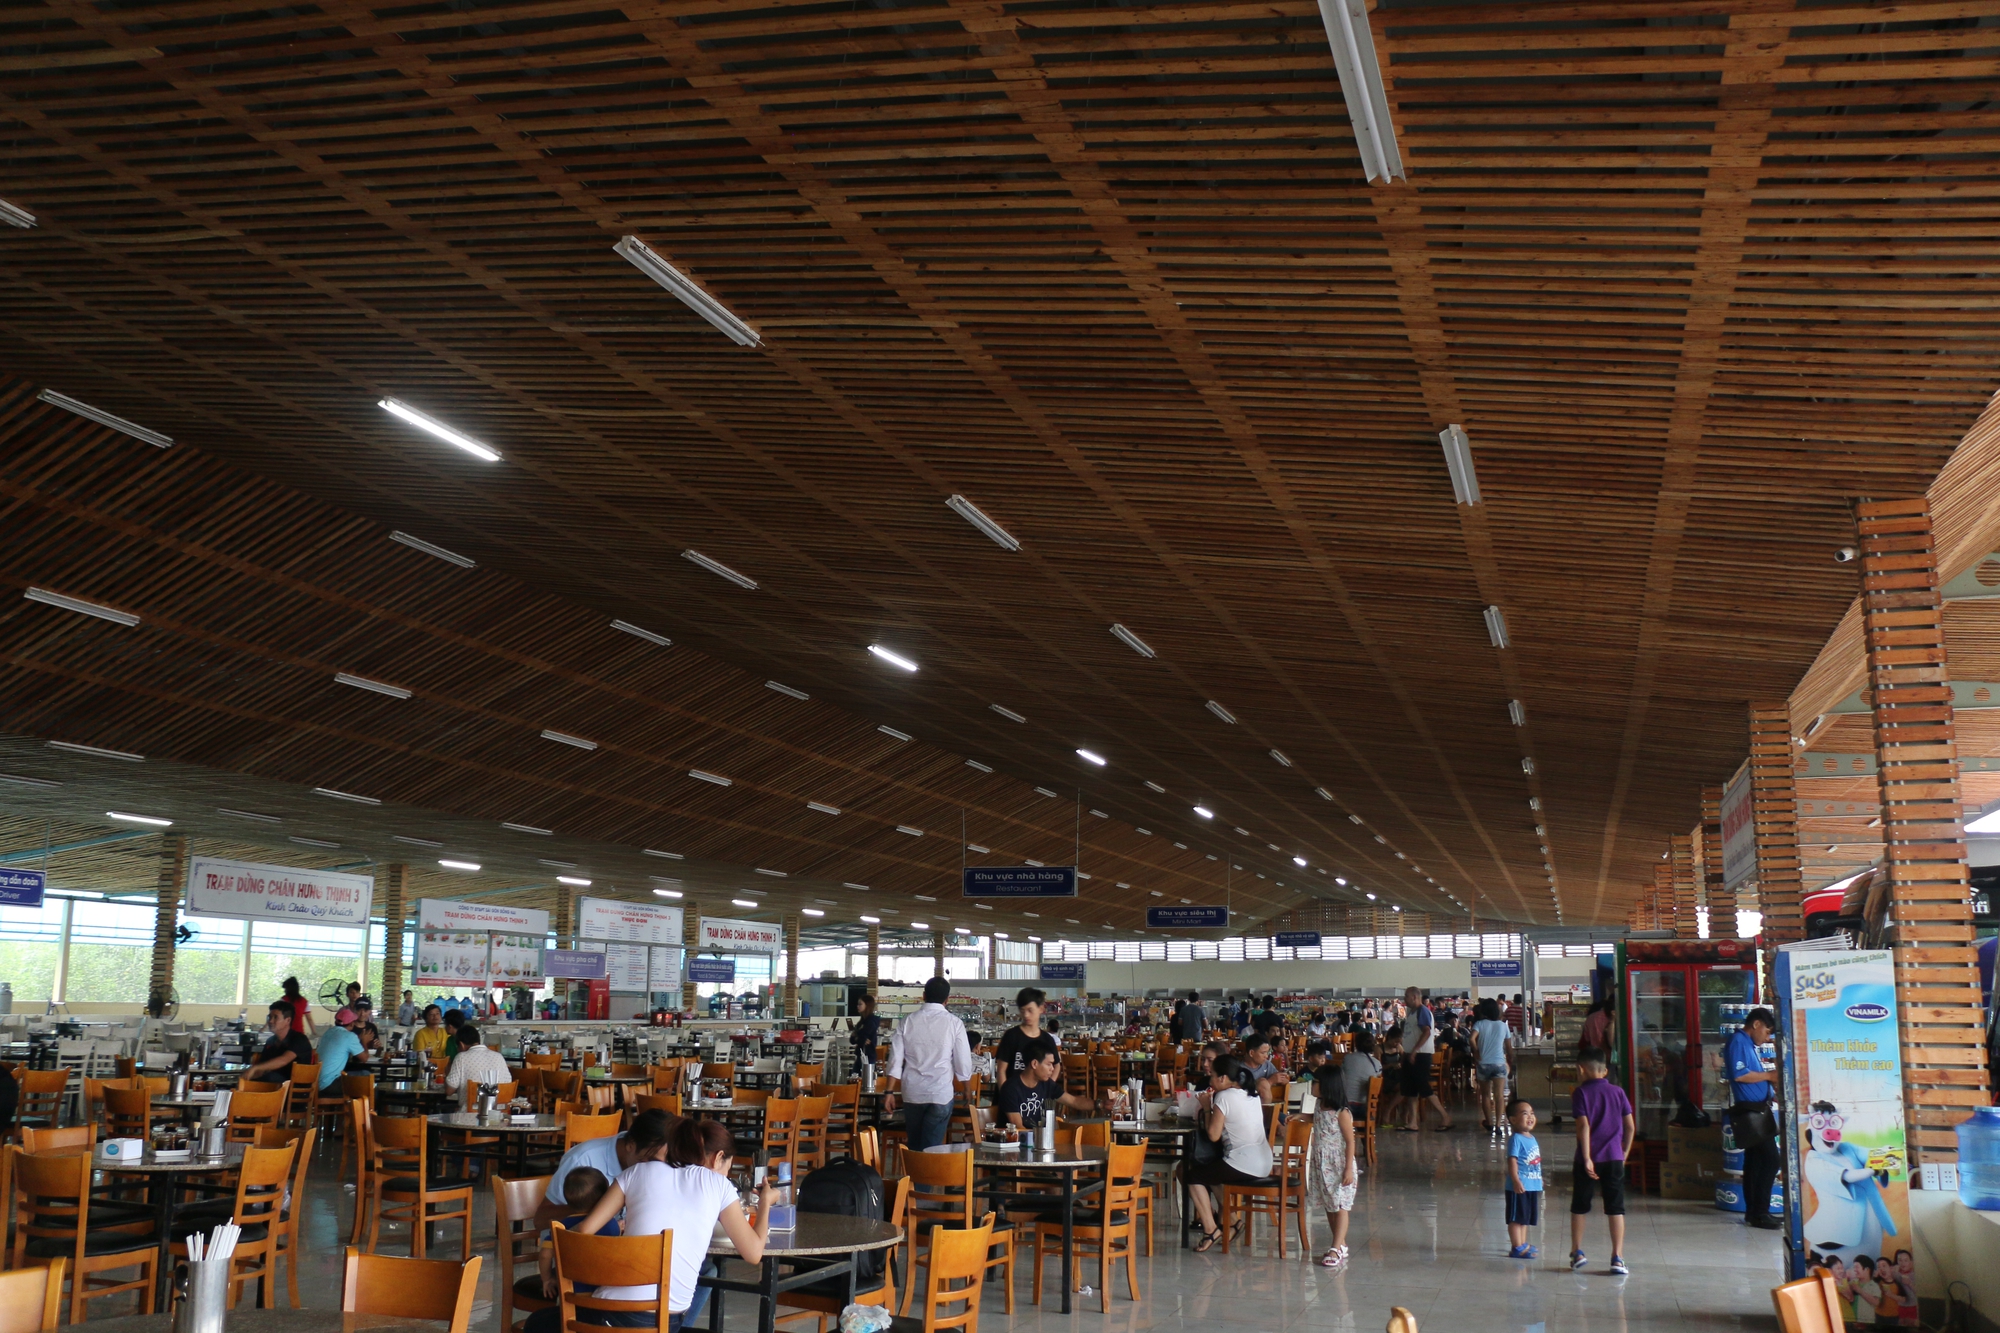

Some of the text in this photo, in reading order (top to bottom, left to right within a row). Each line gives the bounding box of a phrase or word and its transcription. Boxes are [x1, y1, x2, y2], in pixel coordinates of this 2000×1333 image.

[974, 871, 1064, 882] Khu vực nhà hàng
[206, 872, 360, 906] TRẠM DỪNG CHÂN HƯNG THỊNH 3
[995, 884, 1042, 893] Restaurant
[265, 900, 354, 918] Kính Chào Quý Khách
[1206, 910, 1217, 918] thị
[706, 925, 777, 945] TRẠM DỪNG CHÂN HƯNG THỊNH 3
[554, 954, 565, 962] Khu
[576, 955, 587, 964] pha
[588, 955, 599, 964] chế
[1795, 971, 1836, 993] SuSu
[1848, 1008, 1887, 1016] VINAMILK
[1810, 1037, 1845, 1052] Thêm
[1834, 1056, 1895, 1071] Thêm cao
